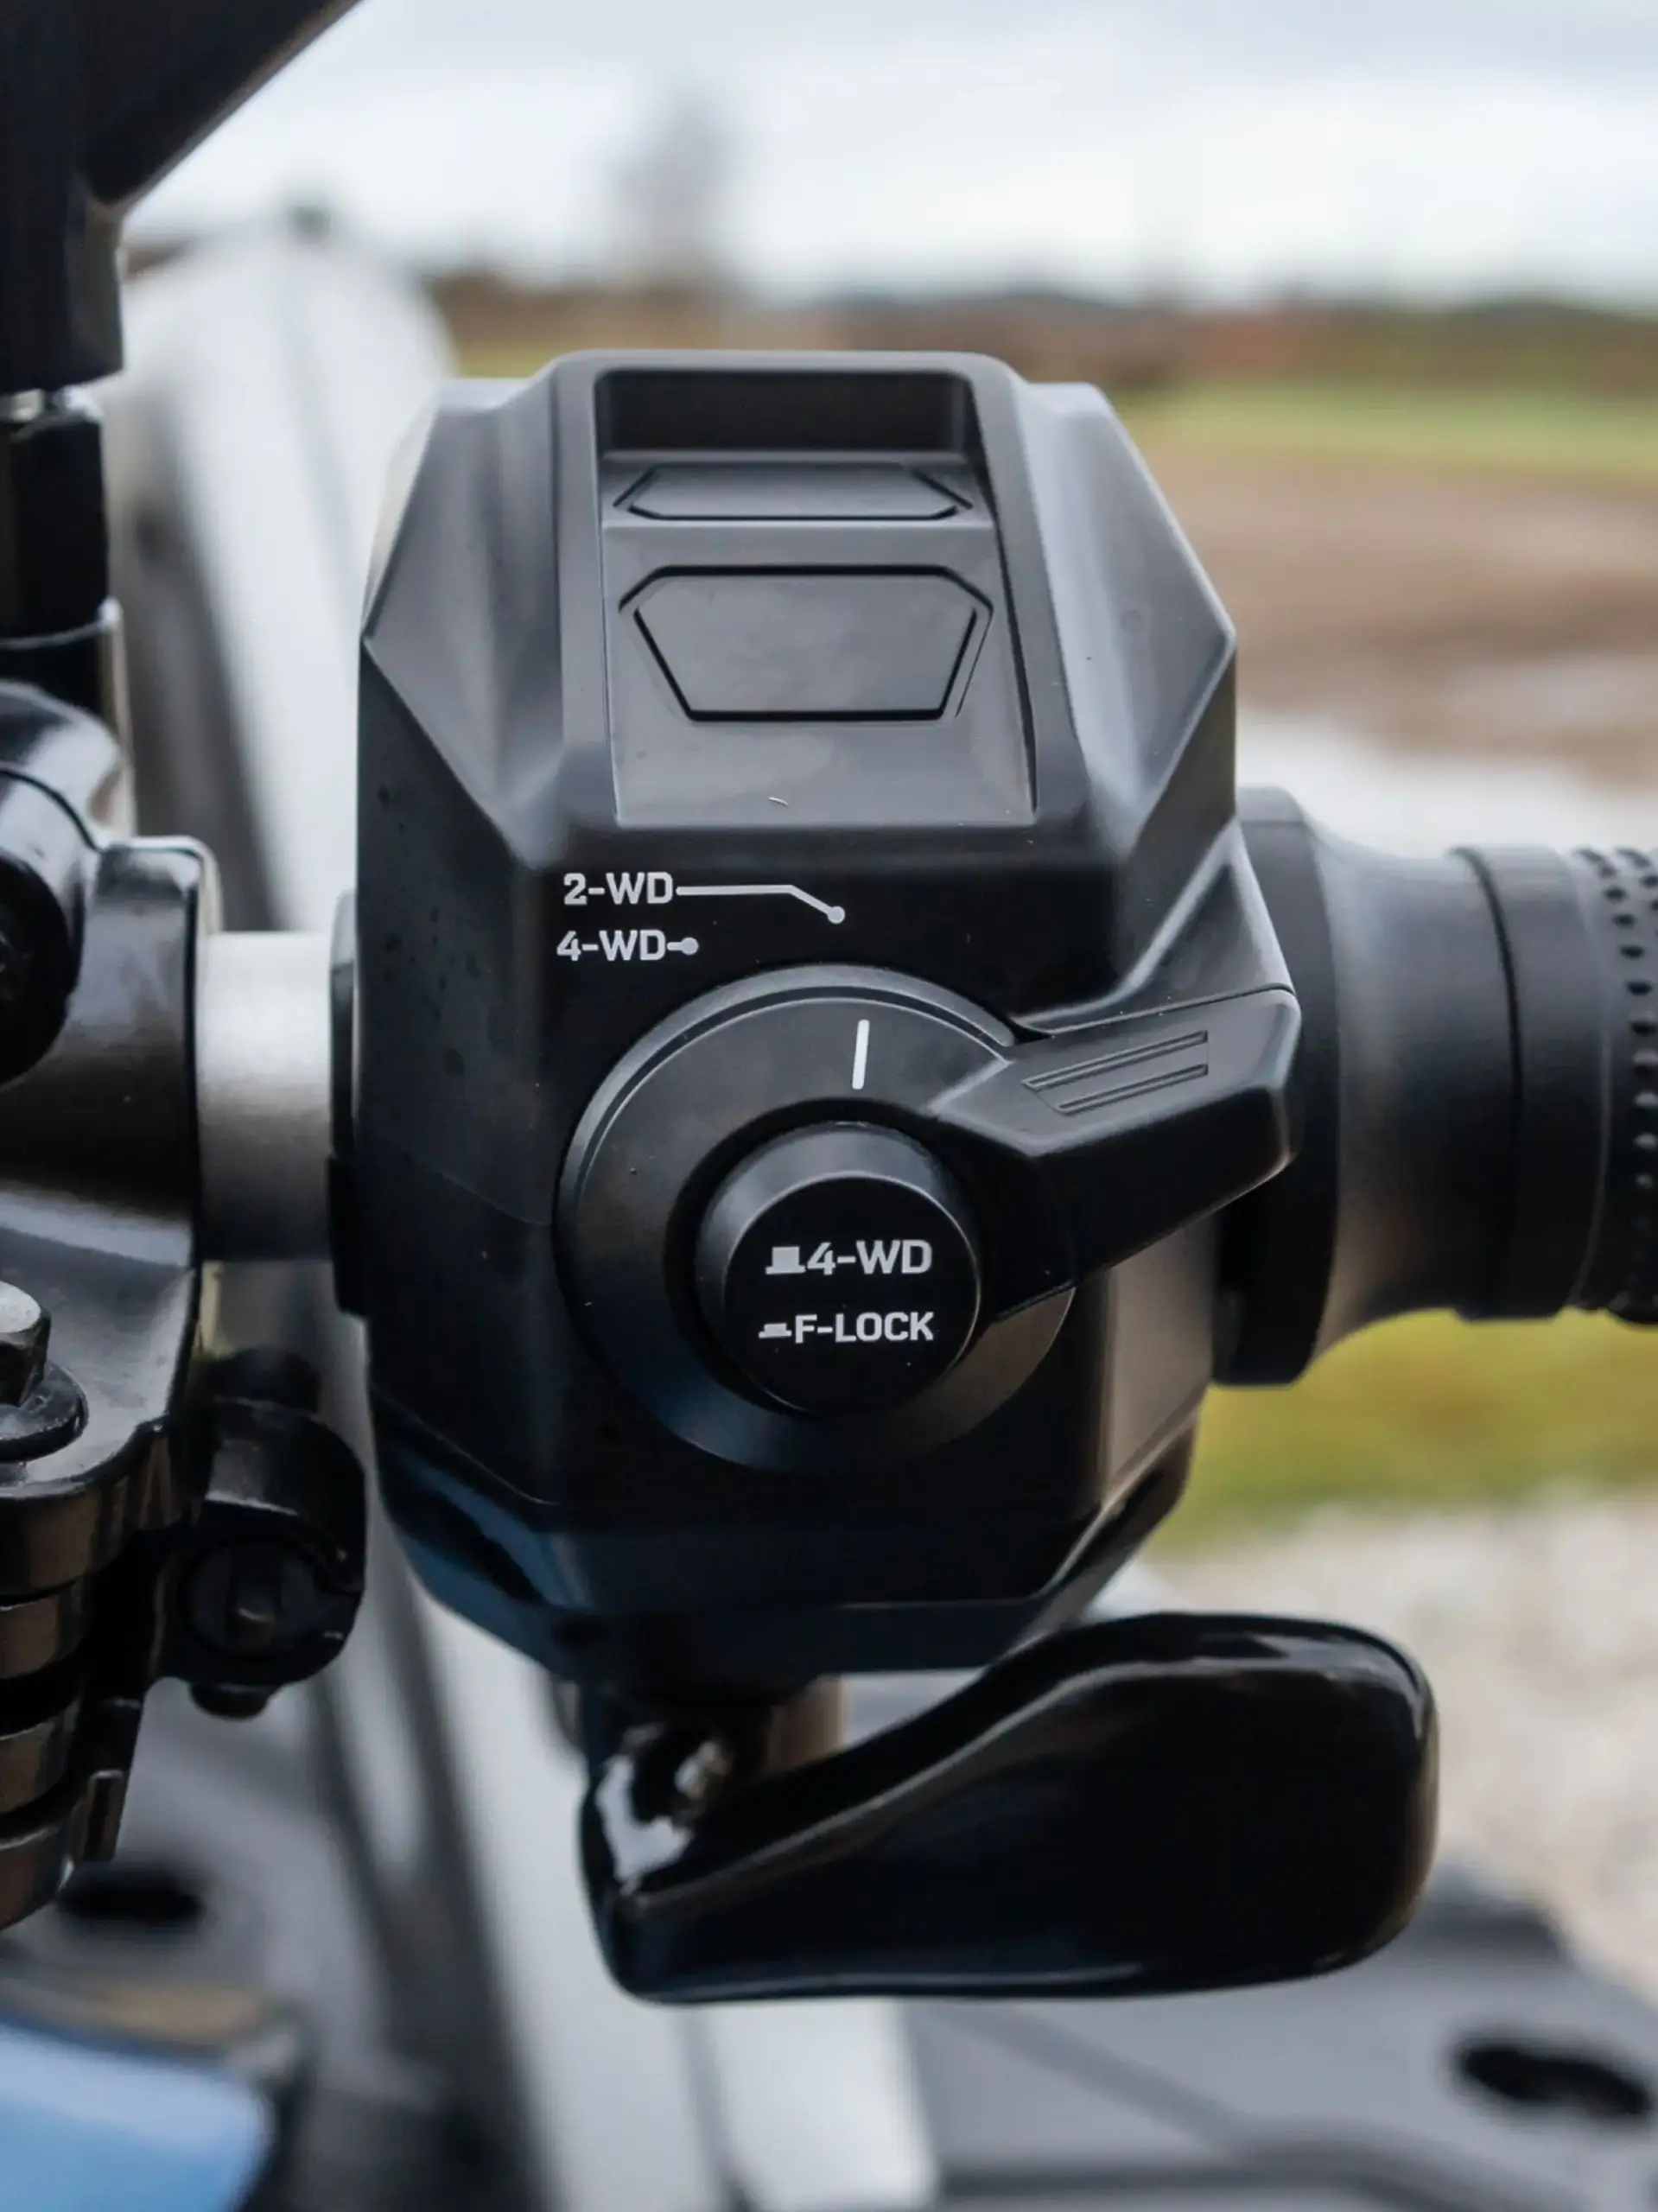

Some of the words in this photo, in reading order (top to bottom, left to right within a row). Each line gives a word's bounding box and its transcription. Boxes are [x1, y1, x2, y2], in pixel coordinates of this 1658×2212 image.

[563, 871, 673, 905] 2-WD
[556, 929, 666, 962] 4-WD
[807, 1239, 932, 1275] 4-WD
[795, 1312, 934, 1344] F-LOCK
